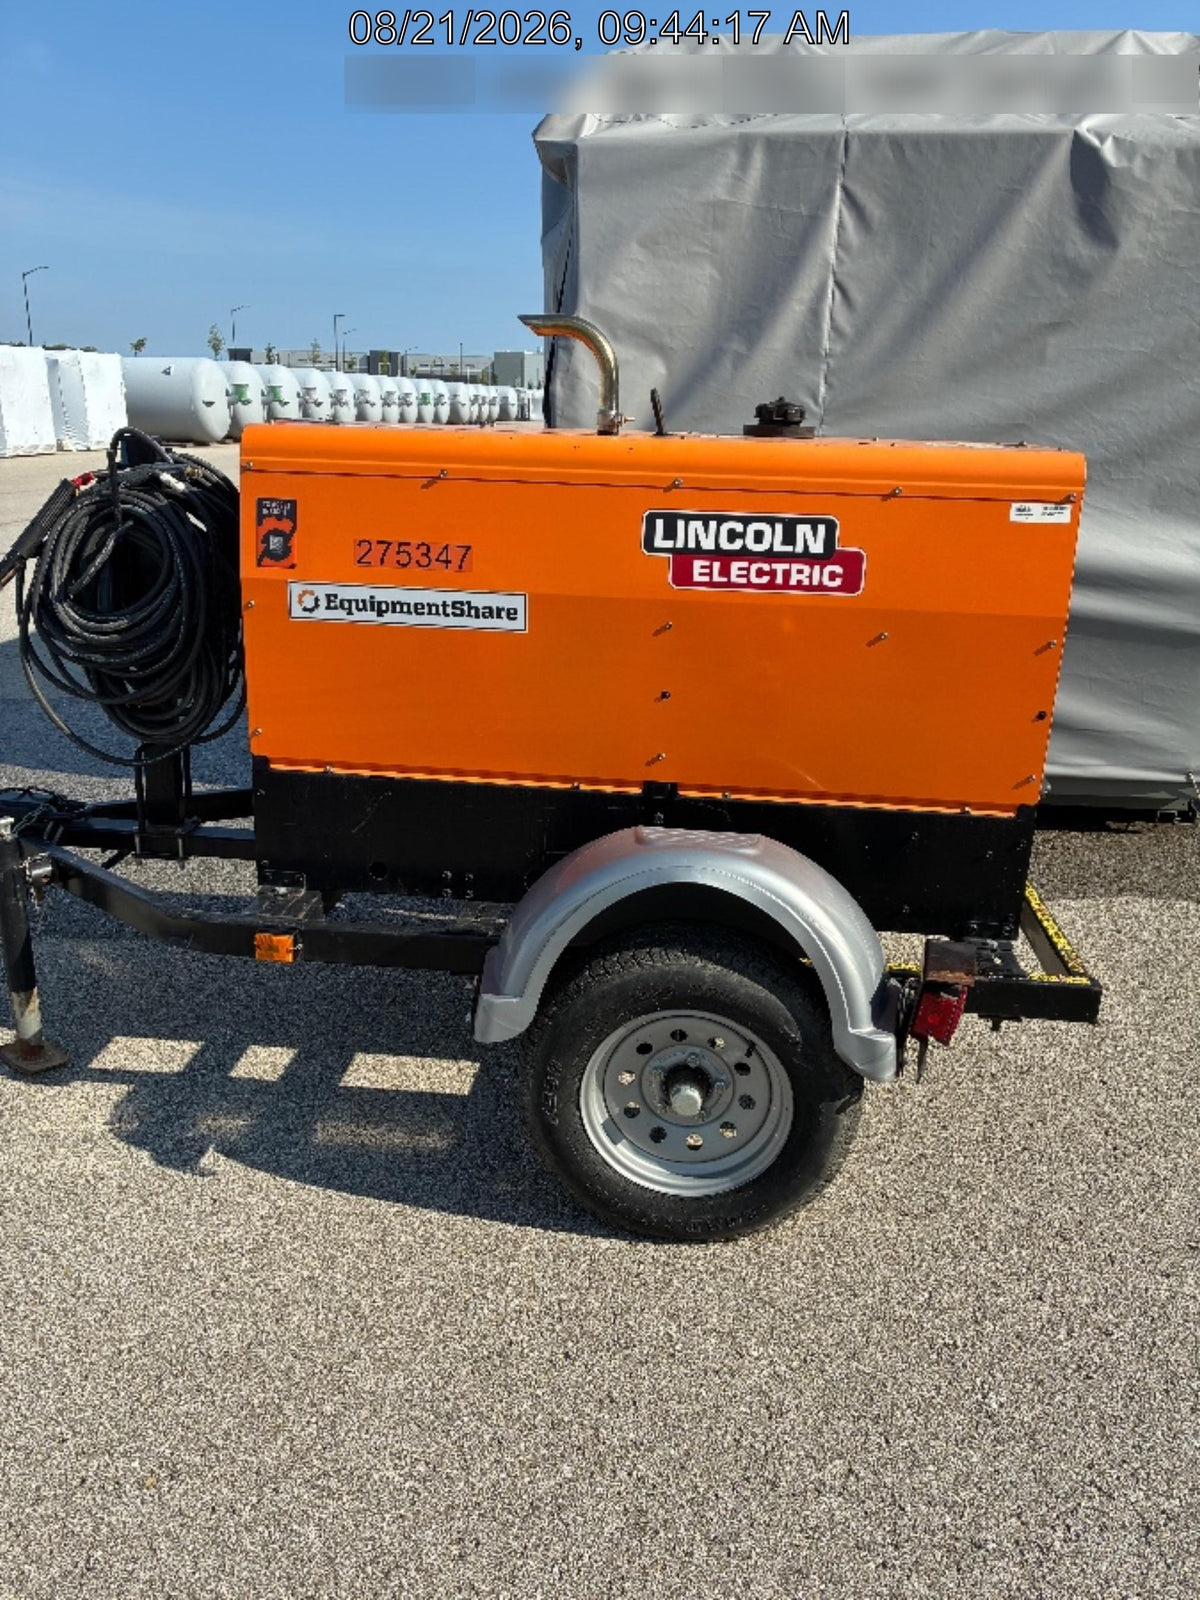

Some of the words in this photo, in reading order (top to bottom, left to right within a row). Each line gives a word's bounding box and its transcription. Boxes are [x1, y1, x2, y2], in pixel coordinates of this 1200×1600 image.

[653, 519, 825, 553] LINCOLN
[356, 540, 472, 570] 275347
[692, 560, 843, 587] ELECTRIC
[325, 593, 518, 621] EquipmentShare
